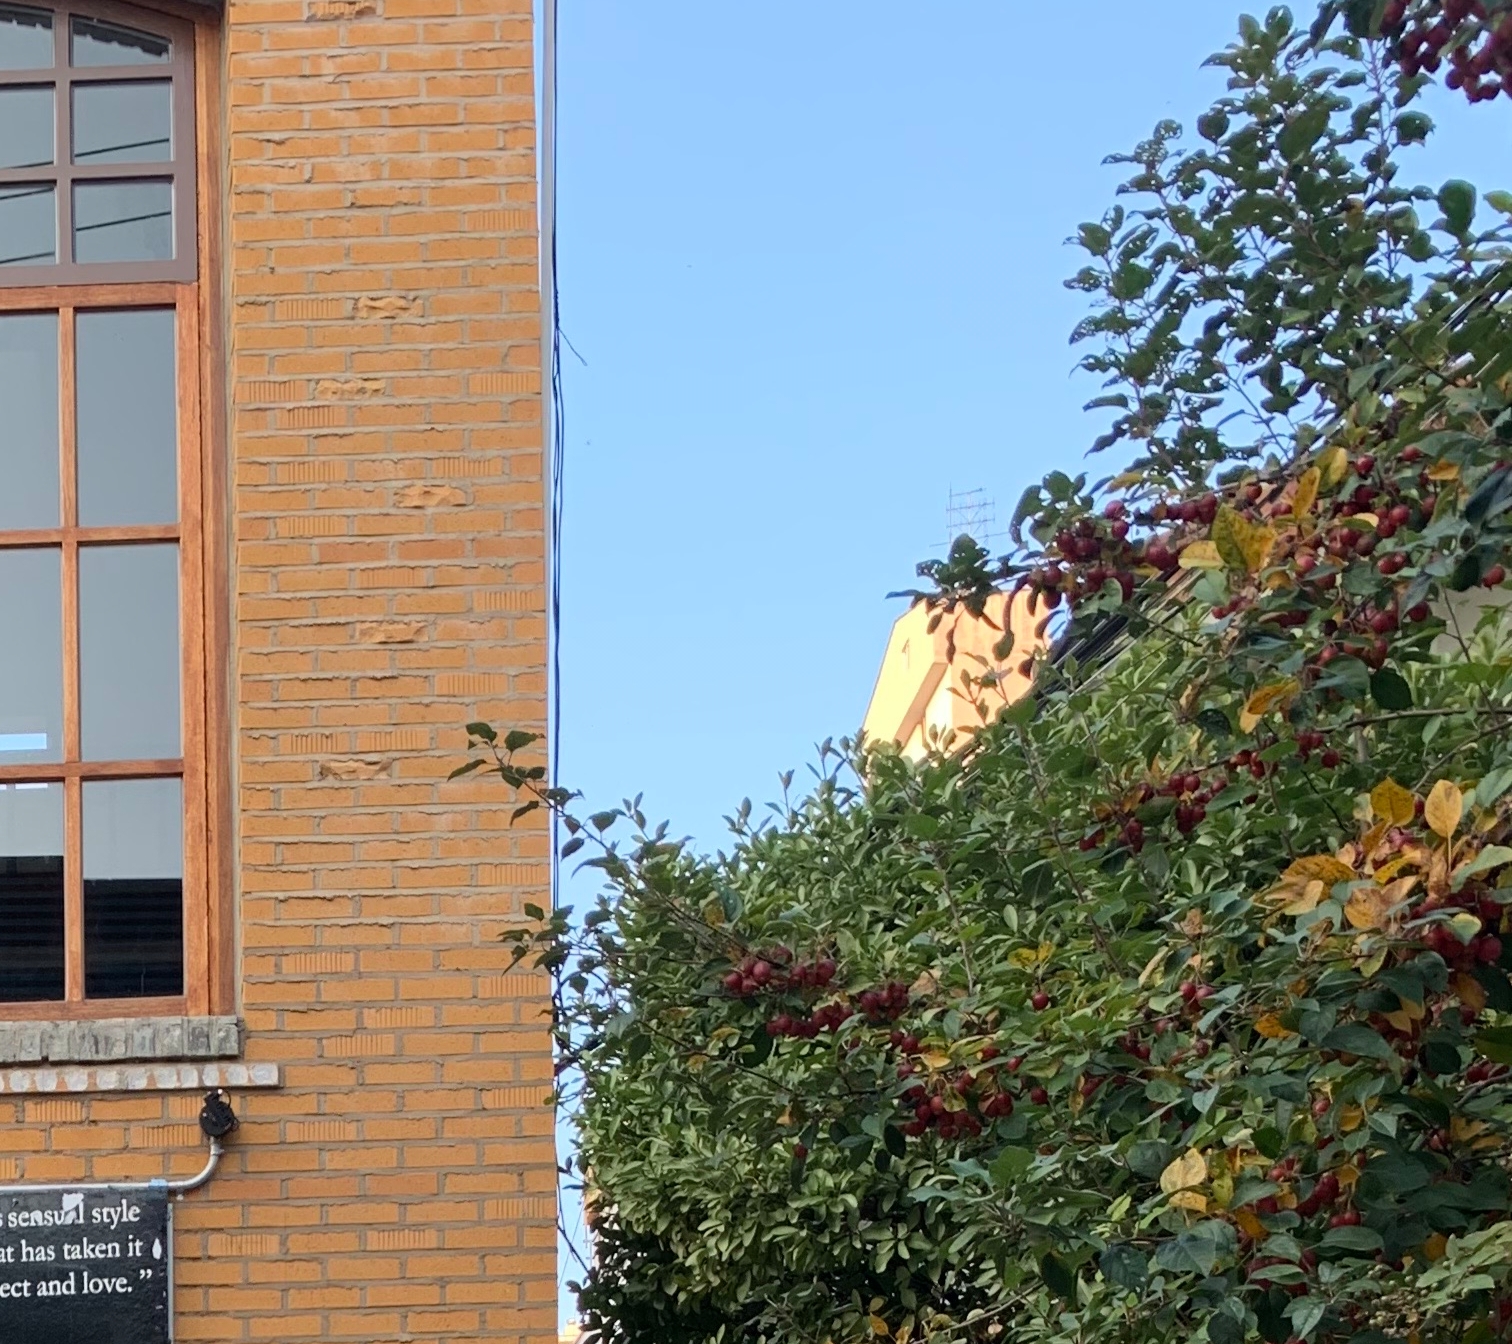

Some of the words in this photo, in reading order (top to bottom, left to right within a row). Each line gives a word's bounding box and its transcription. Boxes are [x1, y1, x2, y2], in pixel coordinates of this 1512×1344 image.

[91, 1199, 140, 1230] style
[20, 1240, 55, 1262] has
[62, 1237, 121, 1260] taken
[127, 1235, 143, 1257] it
[37, 1271, 76, 1296] and
